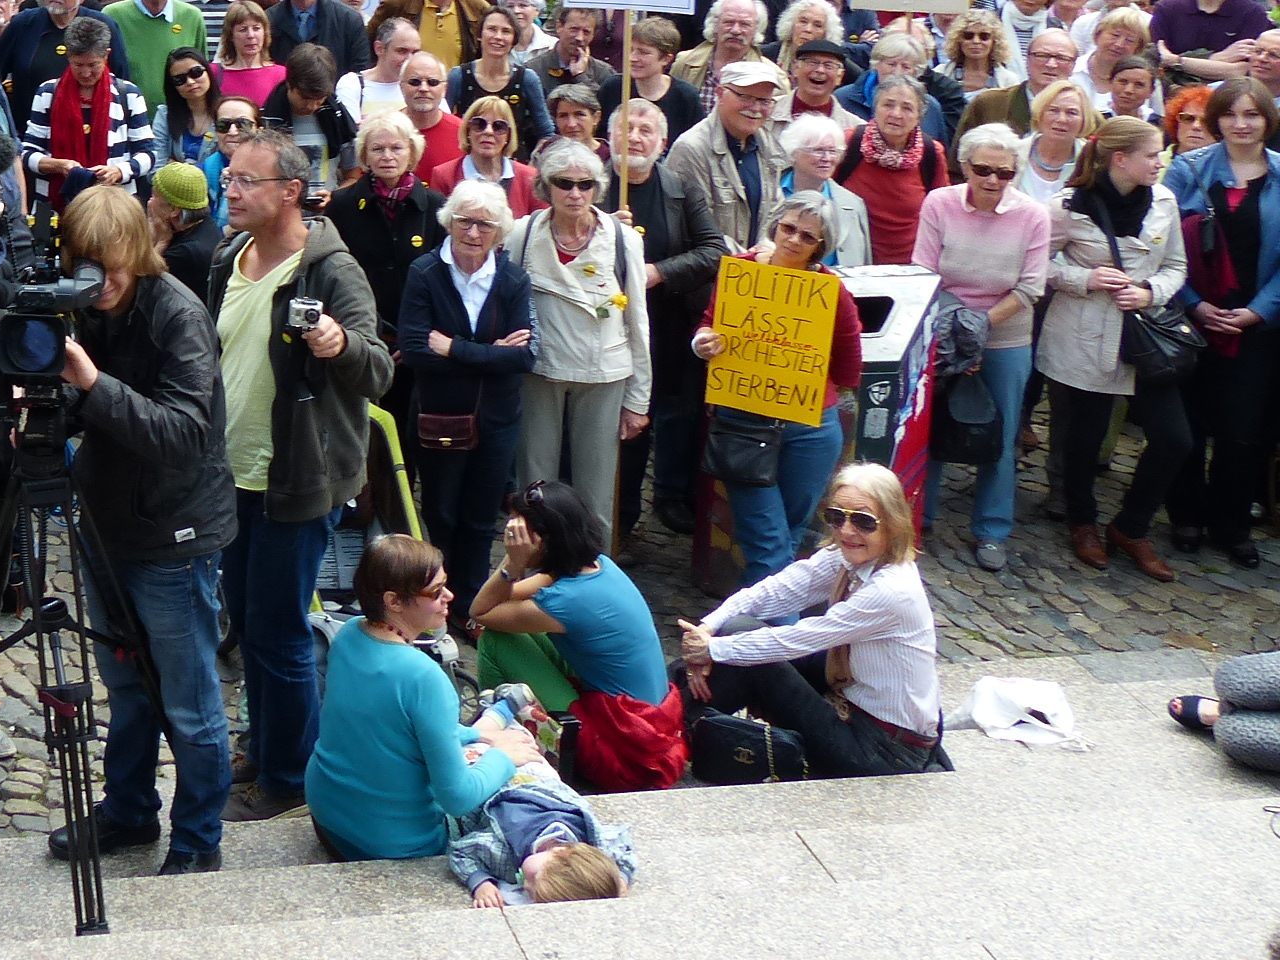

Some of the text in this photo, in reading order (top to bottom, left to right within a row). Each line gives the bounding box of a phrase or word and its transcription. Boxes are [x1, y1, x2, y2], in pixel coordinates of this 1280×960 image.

[720, 301, 812, 340] LÄSST
[720, 333, 825, 377] ORCHESTER
[708, 367, 818, 412] STERBEN!
